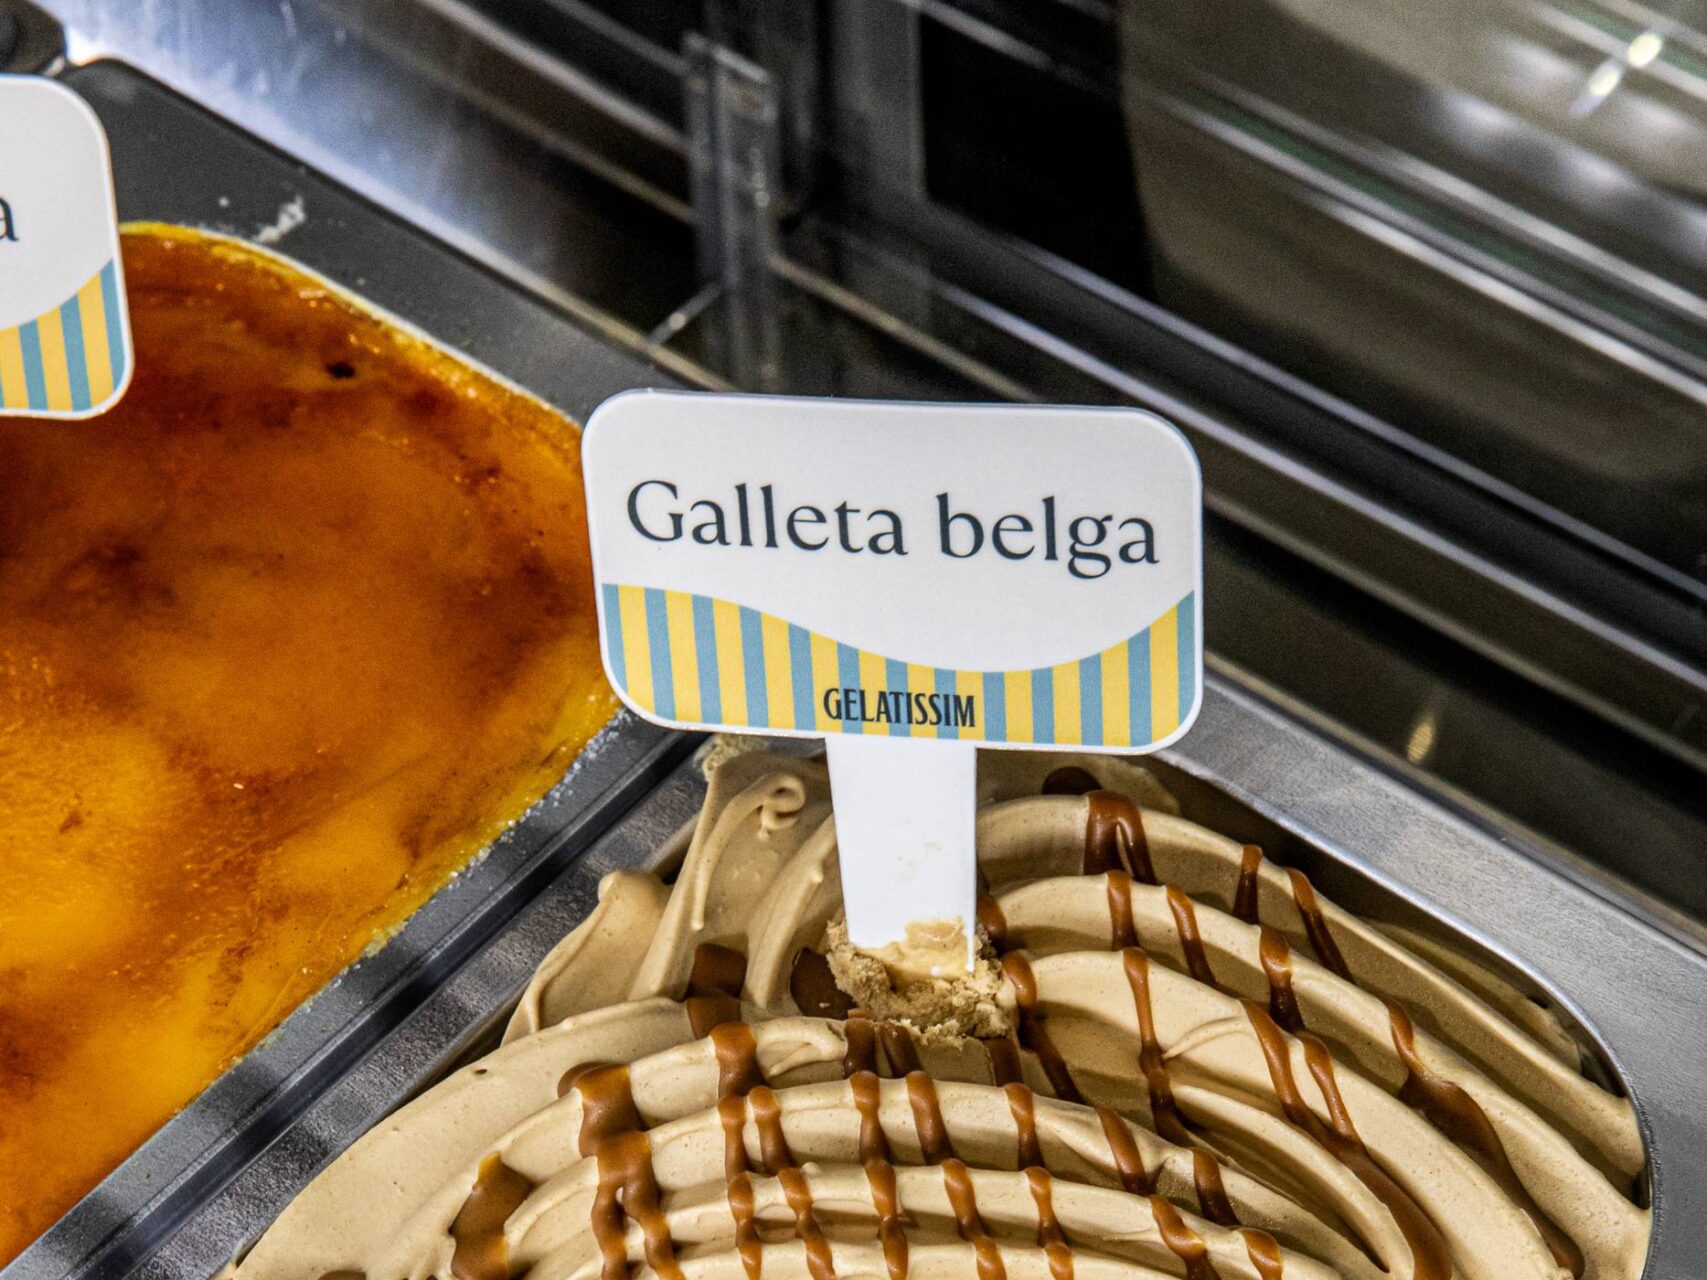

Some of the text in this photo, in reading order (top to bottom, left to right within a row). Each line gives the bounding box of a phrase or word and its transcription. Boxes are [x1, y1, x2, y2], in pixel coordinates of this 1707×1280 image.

[627, 480, 1160, 580] Galleta belga
[822, 687, 976, 728] GELATISSIM
